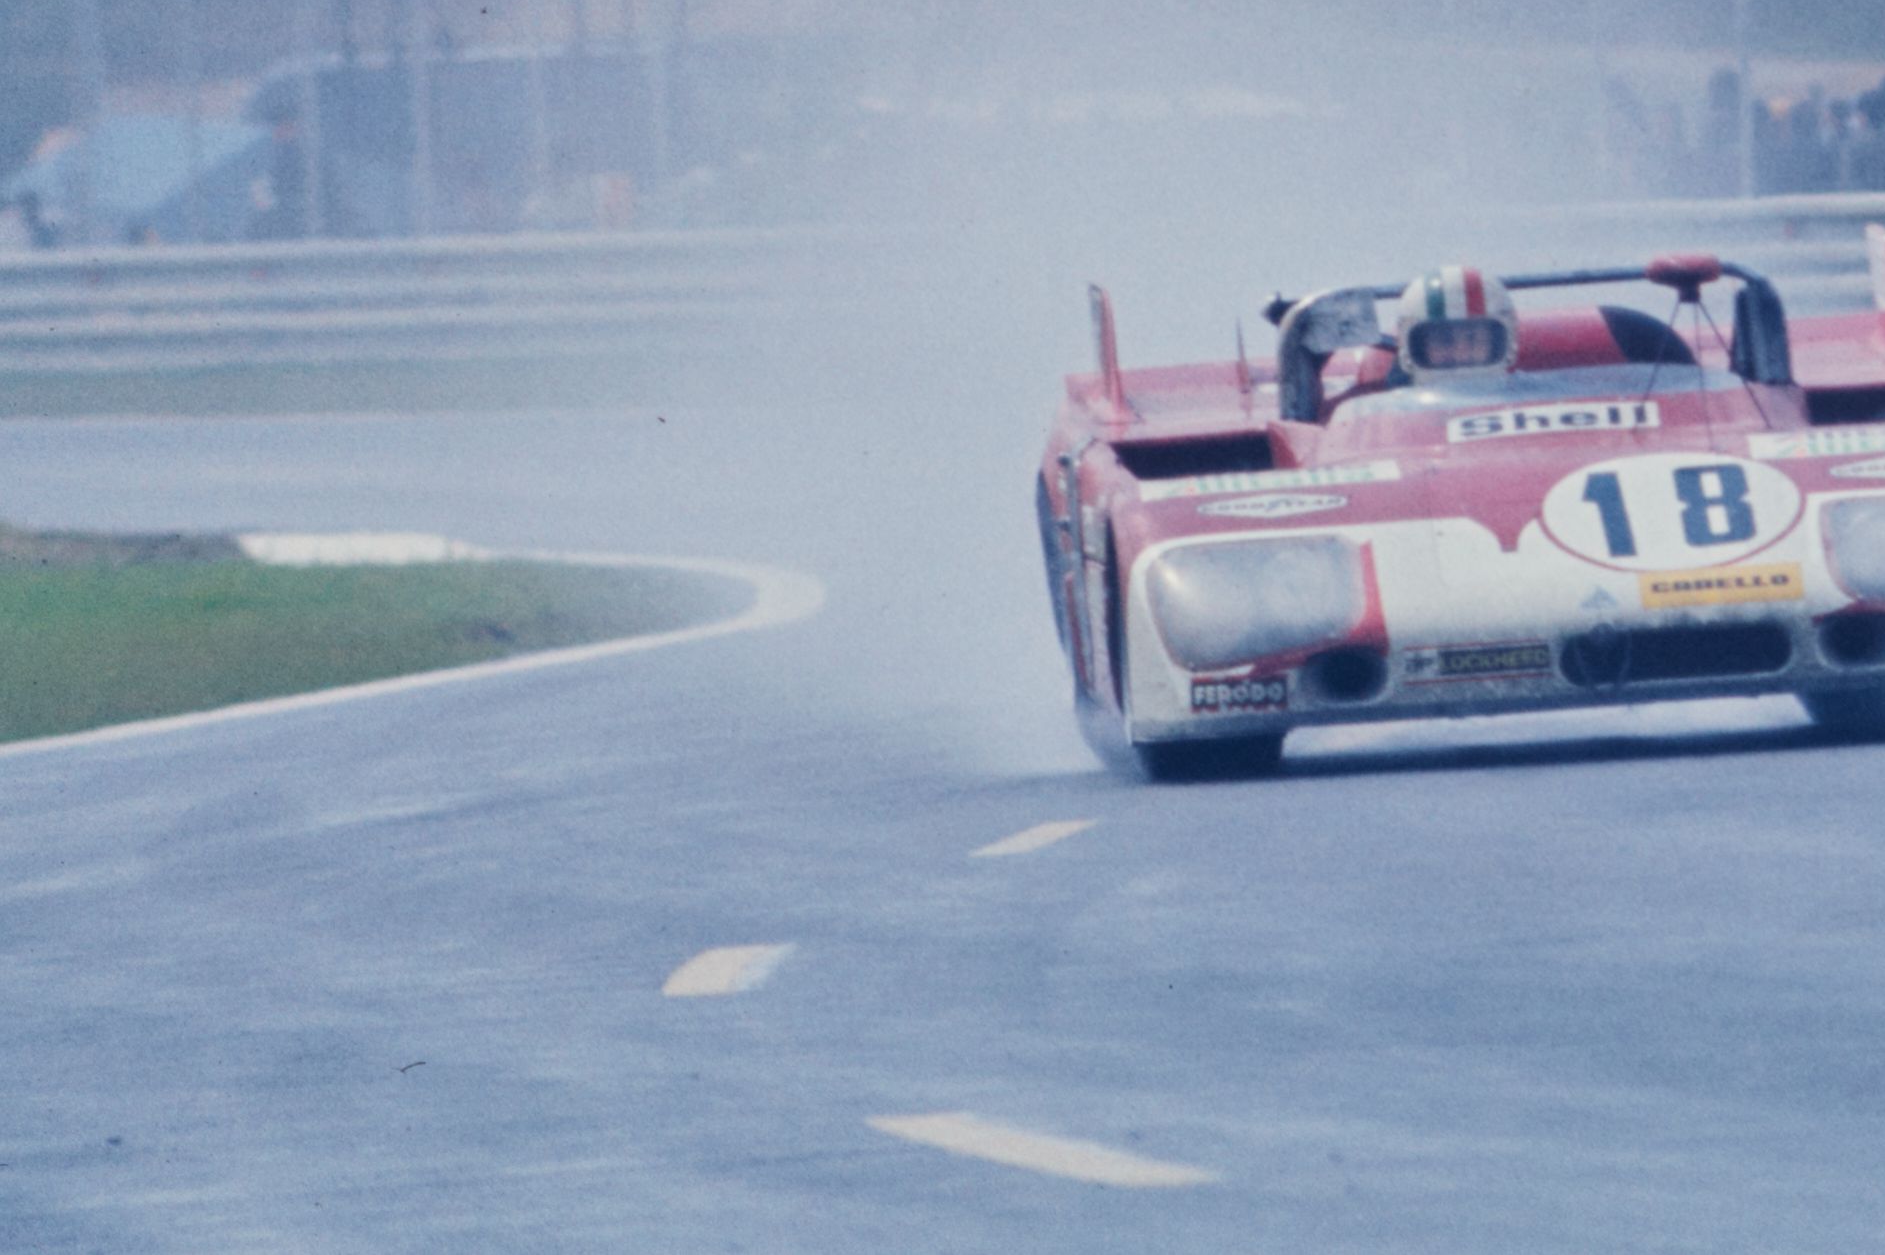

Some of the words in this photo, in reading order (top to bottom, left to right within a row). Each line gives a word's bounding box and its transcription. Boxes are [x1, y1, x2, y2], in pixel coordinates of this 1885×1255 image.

[1461, 405, 1647, 436] Shell
[1581, 463, 1757, 558] 18
[1194, 681, 1284, 705] FERODO
